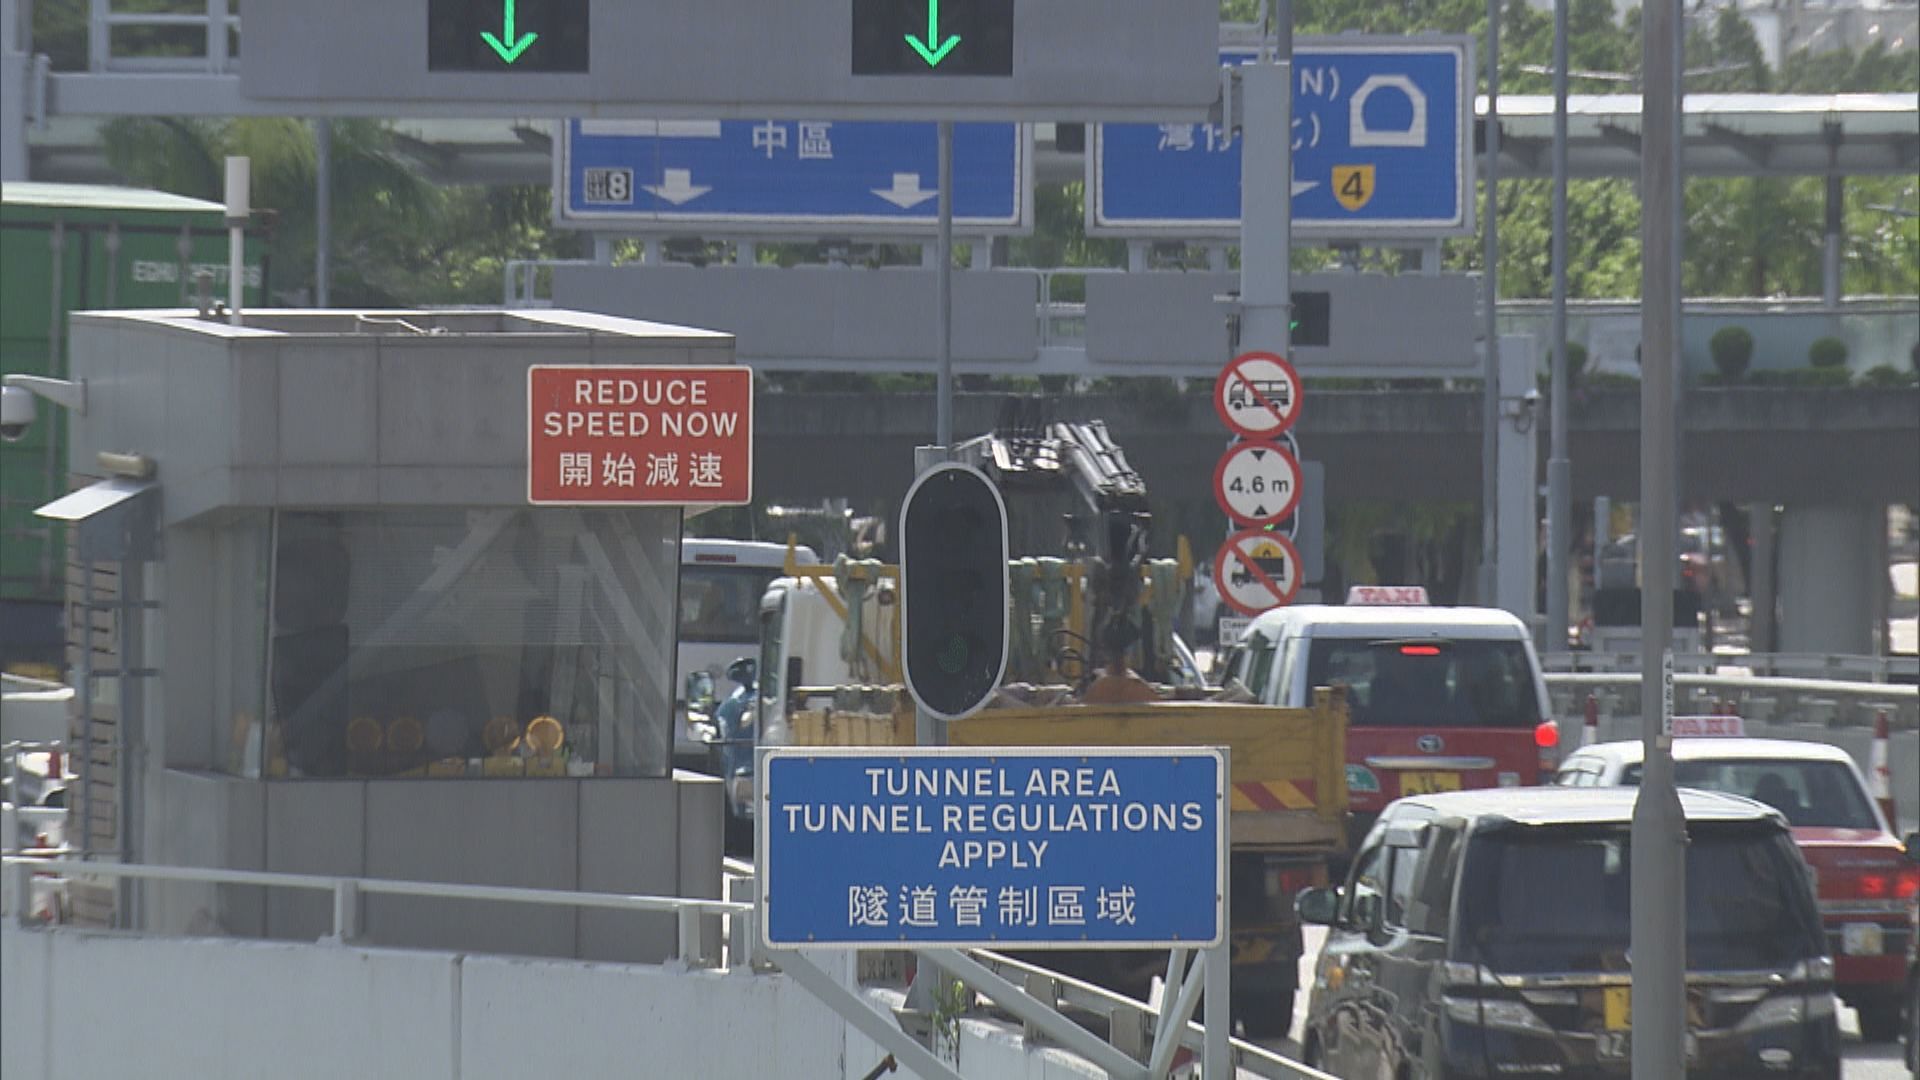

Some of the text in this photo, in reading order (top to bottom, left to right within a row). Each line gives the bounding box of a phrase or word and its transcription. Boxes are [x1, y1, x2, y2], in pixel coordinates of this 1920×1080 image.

[753, 121, 833, 160] 中區
[609, 172, 627, 201] 8
[1341, 171, 1364, 201] 4
[575, 379, 708, 406] REDUCE
[544, 411, 738, 438] SPEED NOW
[559, 452, 723, 488] 開始減速
[1229, 477, 1290, 495] 4.6 m
[1358, 588, 1421, 603] TAXI
[865, 768, 1122, 797] TUNNEL AREA
[783, 802, 1203, 833] TUNNEL REGULATIONS
[938, 840, 1049, 869] APPLY
[847, 884, 1137, 928] 隧道管制區域
